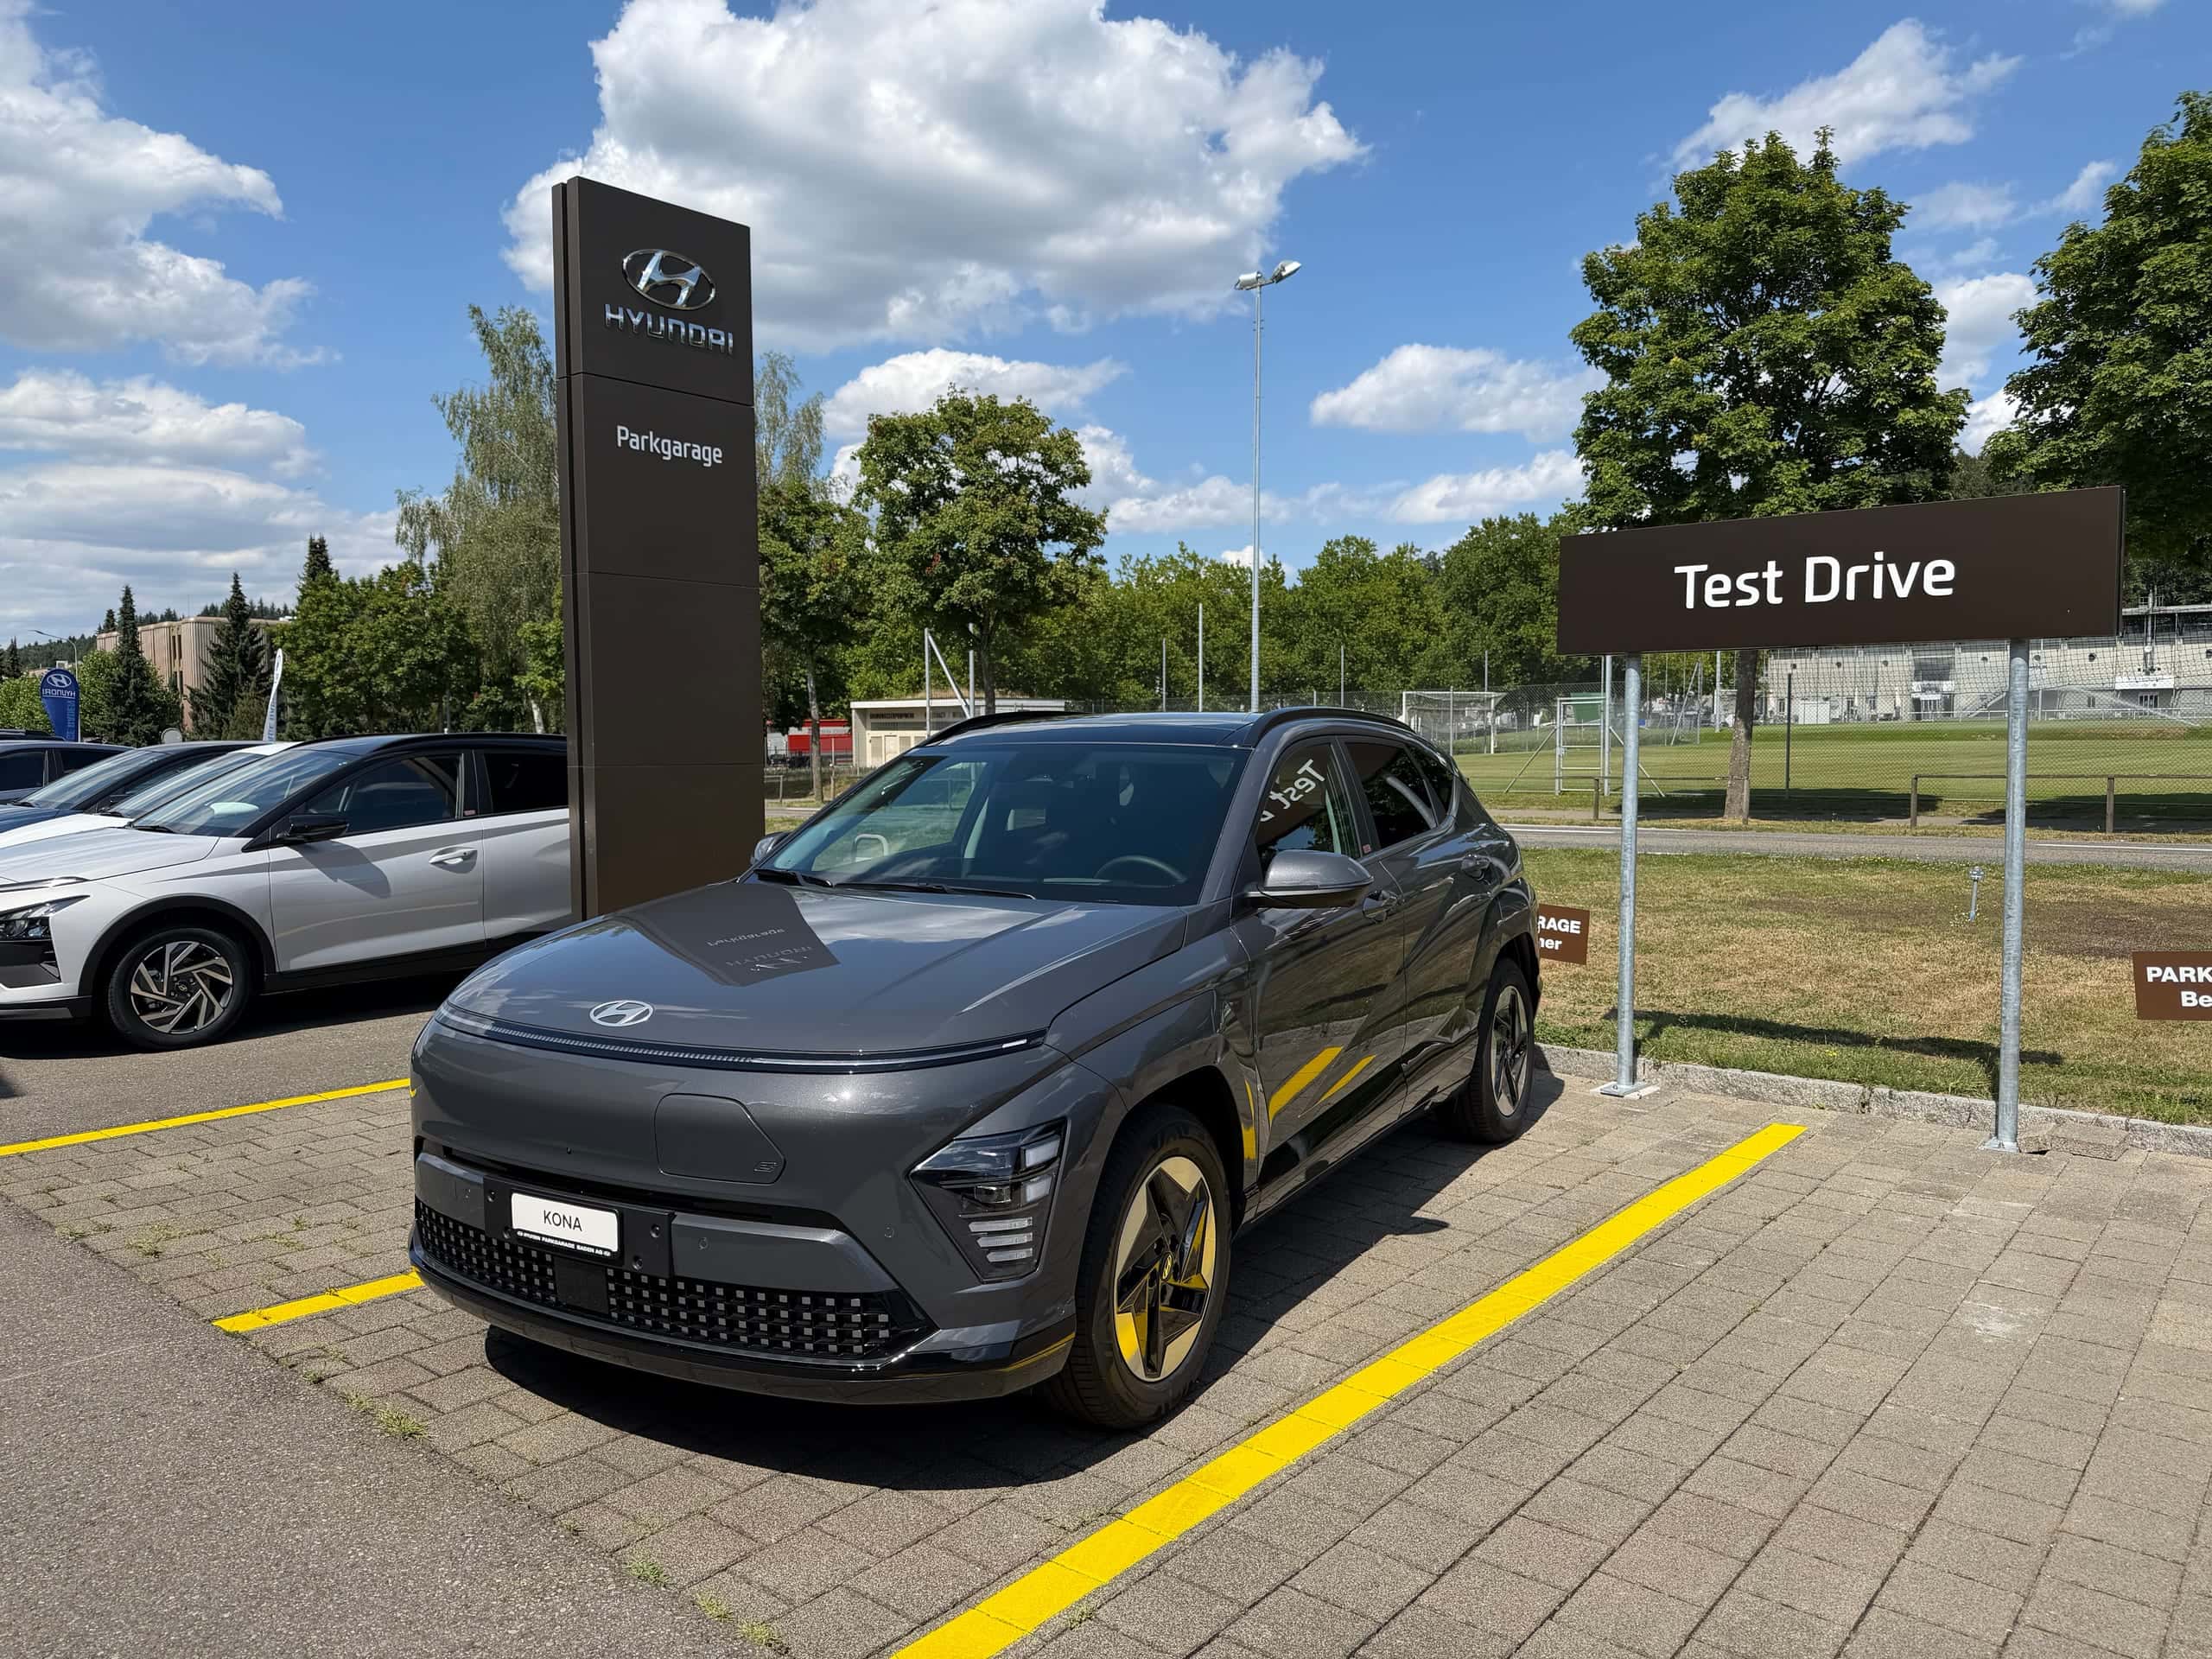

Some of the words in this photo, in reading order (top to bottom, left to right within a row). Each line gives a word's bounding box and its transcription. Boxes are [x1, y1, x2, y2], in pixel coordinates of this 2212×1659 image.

[604, 303, 734, 355] HYUNDAI
[616, 424, 723, 467] Parkgarage
[1674, 560, 1783, 609] Test
[1804, 550, 1955, 603] Drive
[1537, 916, 1581, 934] RAGE
[2146, 966, 2212, 982] PARK
[2181, 990, 2212, 1007] Be
[543, 1210, 582, 1231] KONA
